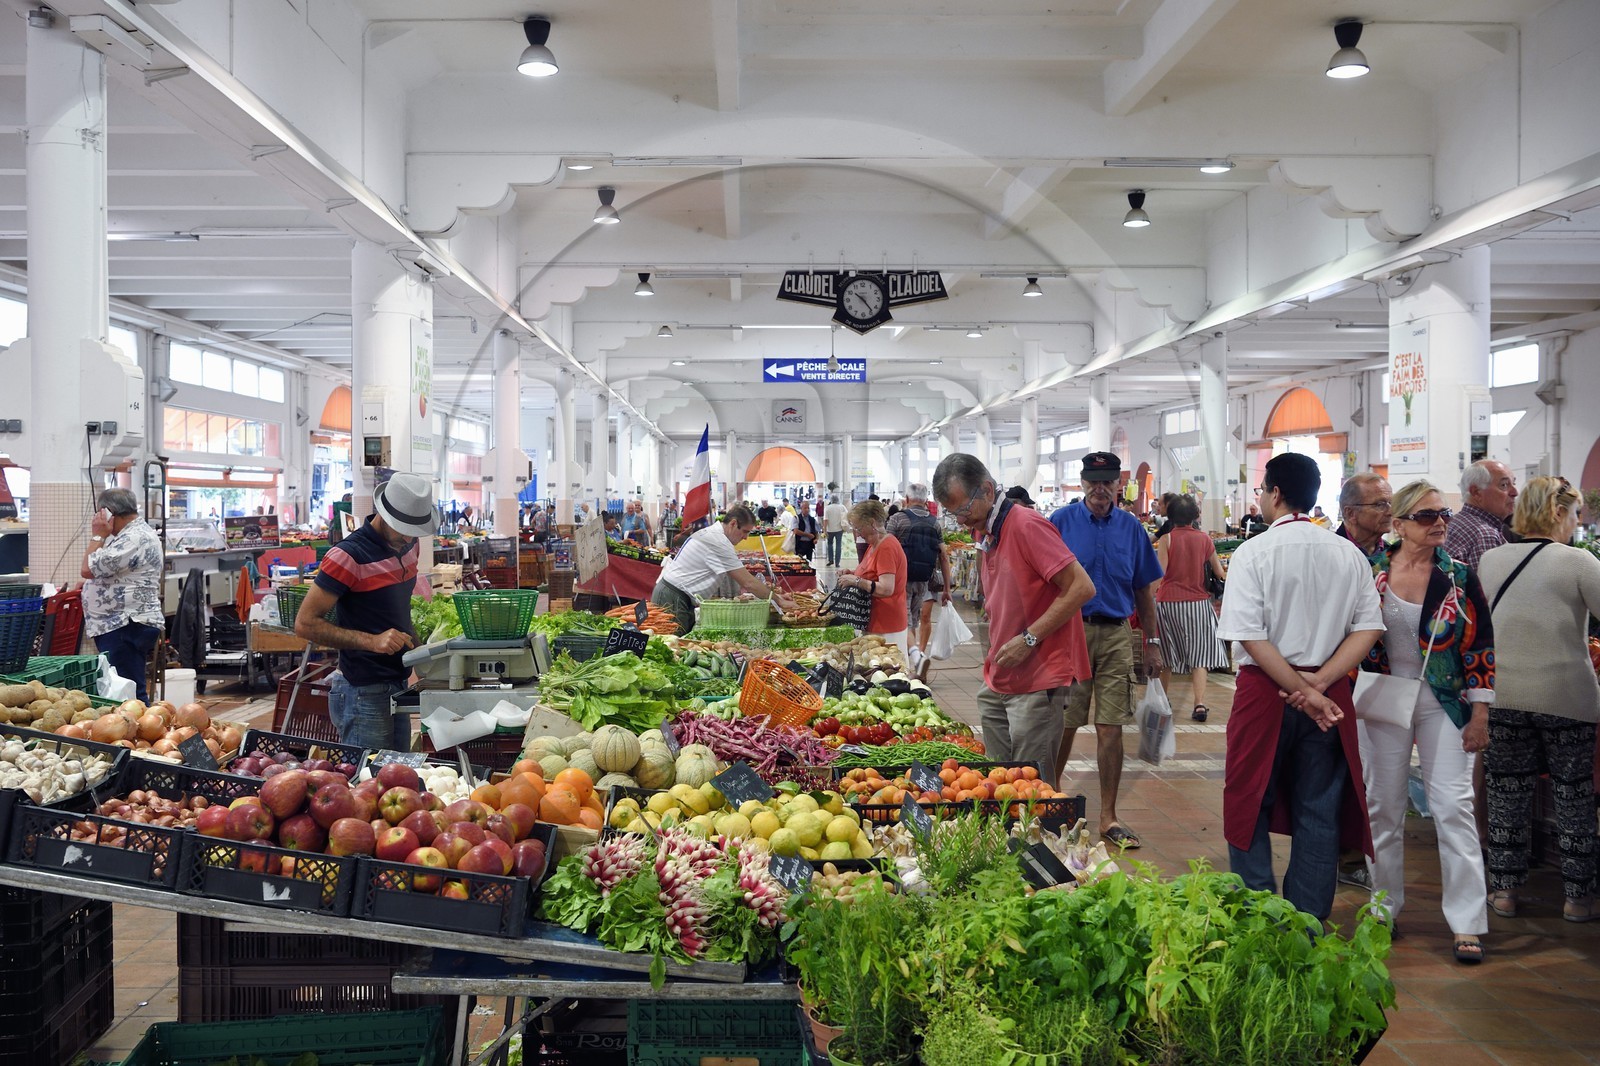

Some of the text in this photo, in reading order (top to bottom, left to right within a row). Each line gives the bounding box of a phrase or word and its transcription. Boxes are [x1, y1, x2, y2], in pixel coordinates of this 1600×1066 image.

[784, 274, 837, 298] CLAUDEL
[888, 274, 941, 298] CLAUDEL
[852, 320, 881, 329] NORMANDIE
[796, 361, 865, 371] PÊCHE CALE
[1394, 352, 1423, 369] C'EST LA
[1392, 365, 1424, 383] FAIM DES
[1390, 380, 1422, 397] HARICOTS
[133, 401, 140, 411] 64
[775, 415, 803, 423] CANNES
[608, 629, 646, 651] Blettes
[577, 1033, 628, 1051] Roy
